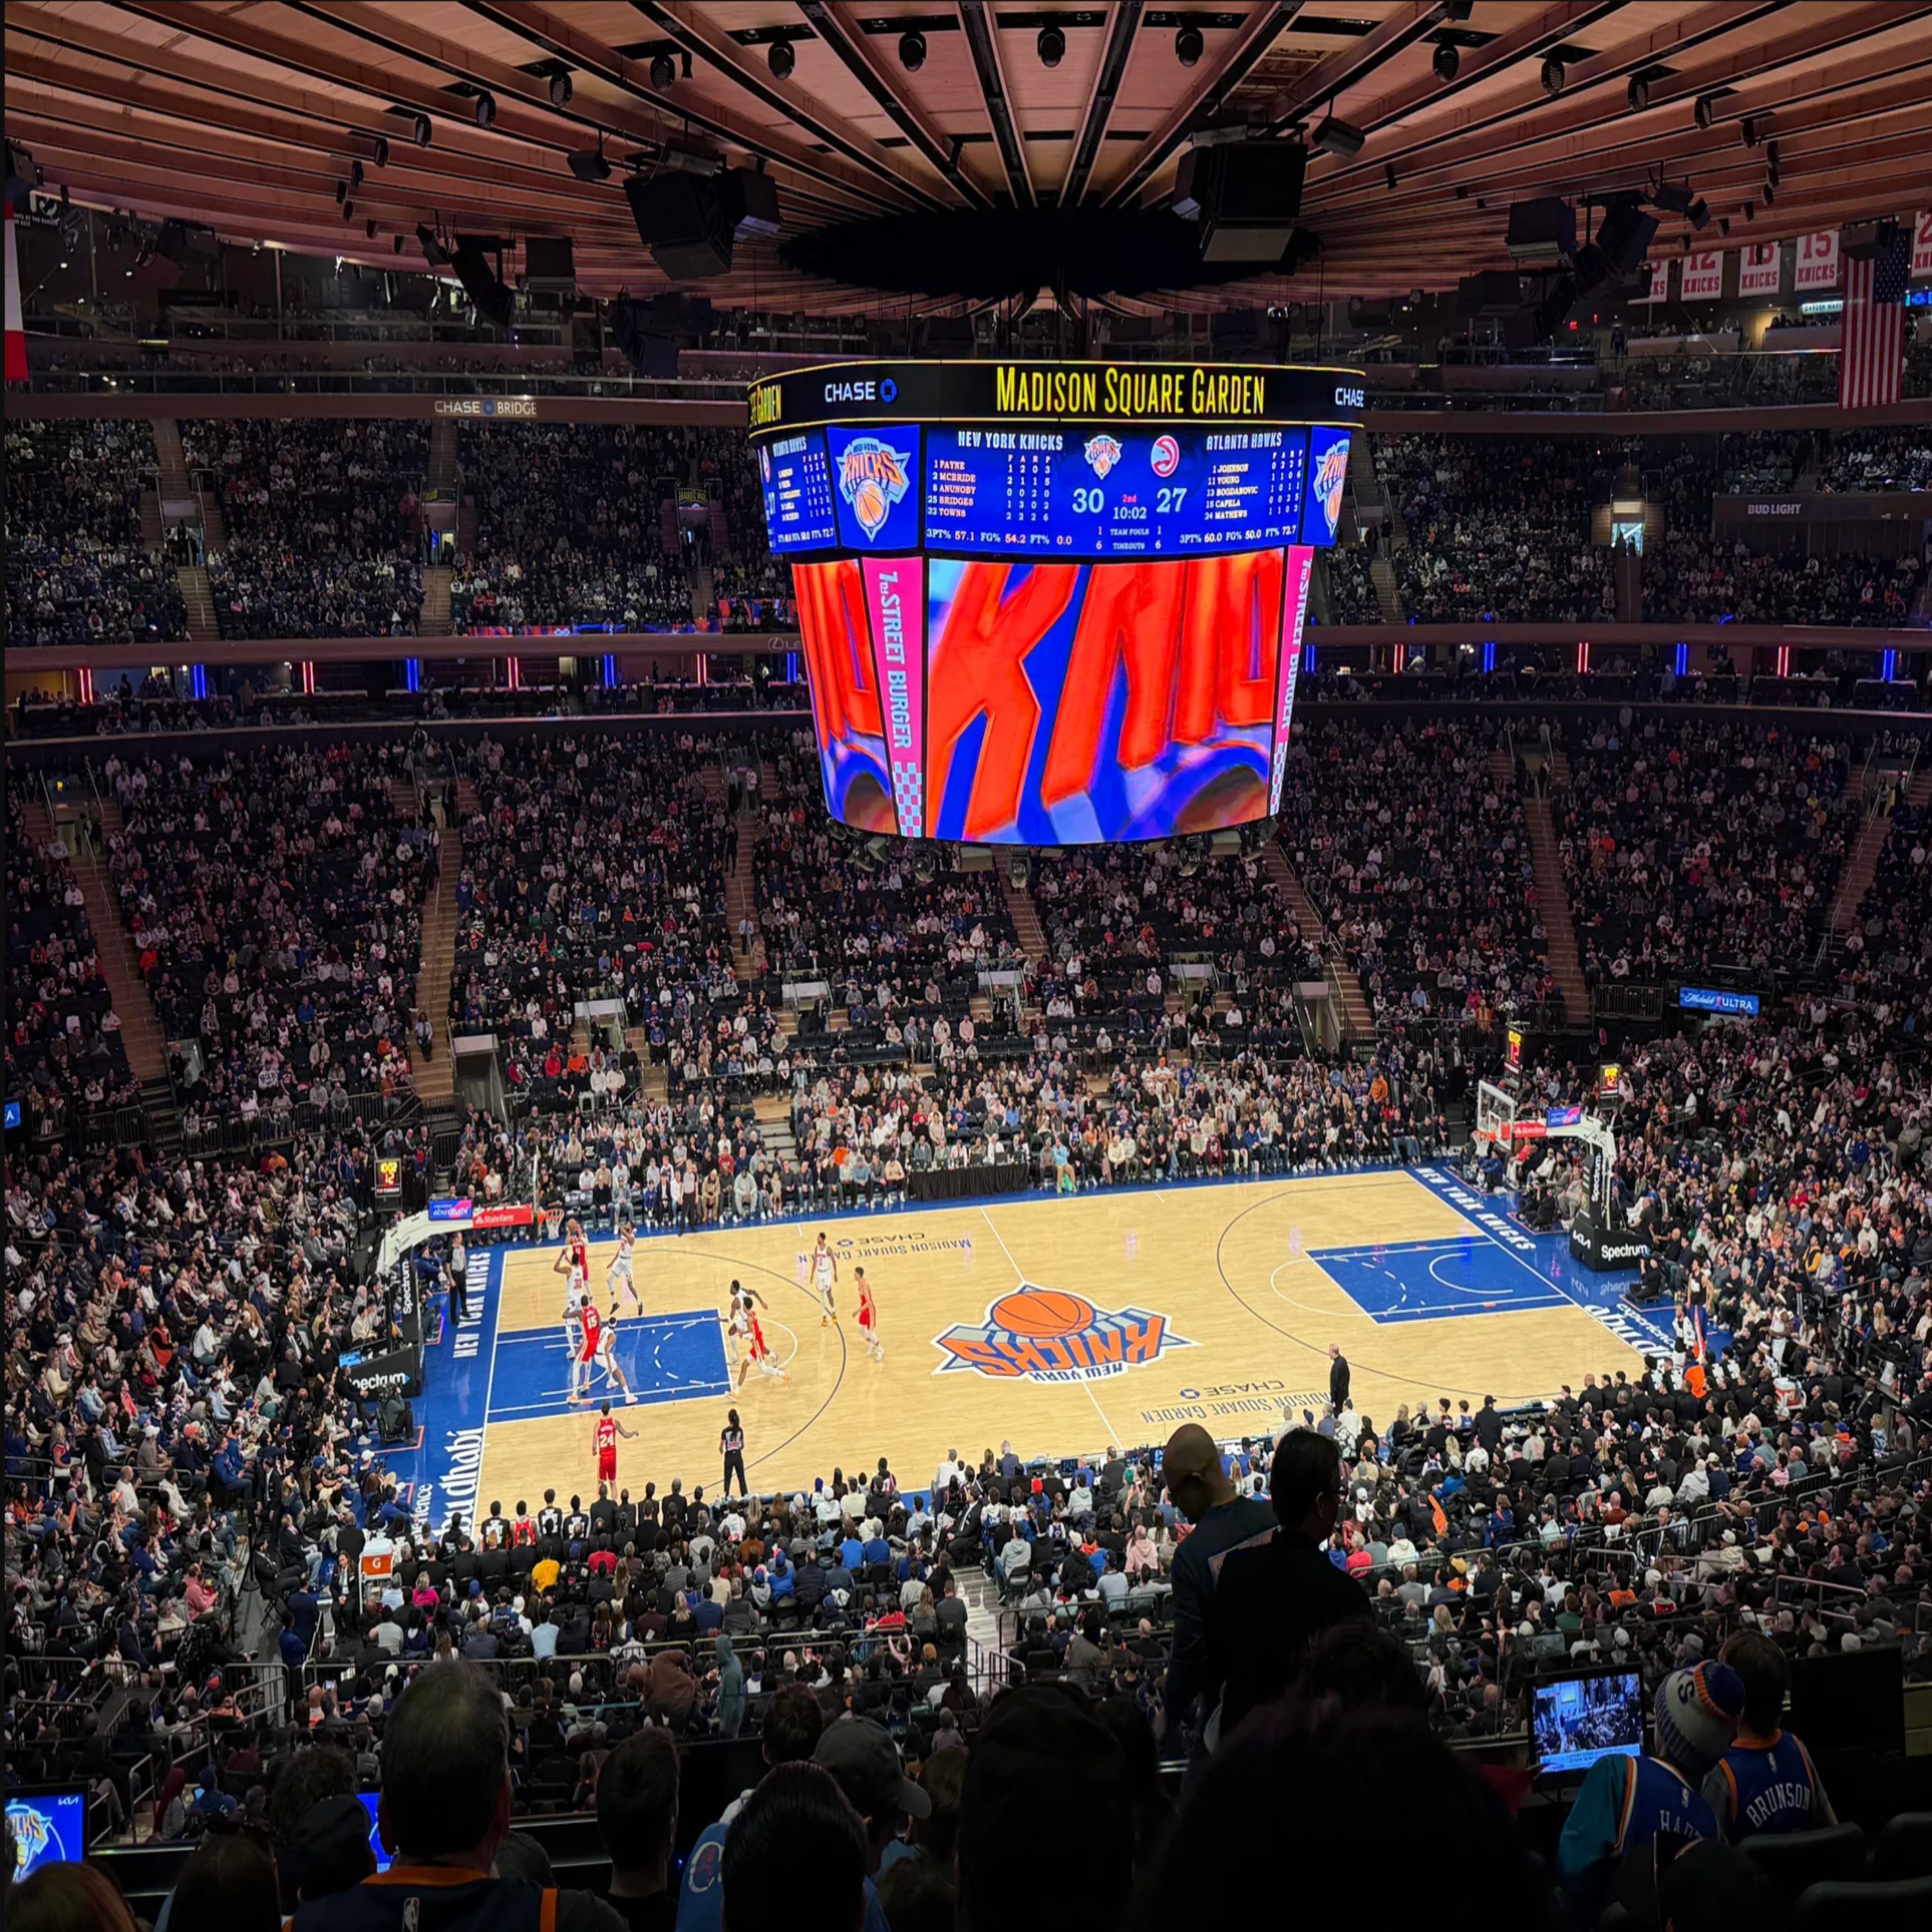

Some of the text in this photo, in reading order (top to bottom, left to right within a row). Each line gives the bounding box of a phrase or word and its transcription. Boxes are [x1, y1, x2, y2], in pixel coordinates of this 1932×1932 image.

[1741, 271, 1777, 290] KNICKS
[1797, 264, 1835, 283] KNICKS
[1683, 276, 1720, 293] KNICKS
[825, 381, 876, 402] CHASE
[997, 367, 1264, 416] MADISON SQUARE GARDEN
[1335, 387, 1364, 408] CHASE
[435, 401, 537, 415] CHASE BRIDGE
[958, 431, 1063, 451] NEW YORK KNICKS
[1206, 431, 1282, 451] ATLANTA HAWKS
[844, 451, 905, 487] KNICKS
[934, 460, 938, 468] 1
[940, 460, 965, 470] PAYNE
[940, 473, 976, 482] MCBRIDE
[1217, 476, 1240, 485] YOUNG
[939, 485, 976, 495] ANUNOBY
[1122, 494, 1137, 503] 2nd
[939, 497, 974, 506] BRIDGES
[1072, 488, 1104, 513] 30
[1156, 487, 1188, 513] 27
[1215, 499, 1240, 508] CAPELA
[939, 508, 966, 517] TOWNS
[1113, 507, 1147, 520] 10:02
[1215, 510, 1247, 520] MATHEWS
[1748, 504, 1801, 515] BUD LIGHT
[926, 528, 1072, 545] 3PT% 57.1 FG% 54.2 FT% 0.0
[1098, 526, 1102, 535] 1
[1157, 526, 1161, 535] 1
[1179, 525, 1296, 544] 3PT% 60.0 FG% 50.0 FT% 72.7
[1096, 540, 1102, 549] 6
[1155, 540, 1161, 549] 6
[881, 594, 905, 665] STREET
[887, 670, 912, 749] BURGER
[1722, 998, 1754, 1010] ULTRA
[1591, 1153, 1602, 1202] Spectrum
[1416, 1168, 1537, 1249] NEW YORK KNICKS
[857, 1233, 925, 1245] CHASE
[911, 1238, 972, 1252] MADISON
[1572, 1229, 1591, 1250] KIA
[857, 1244, 907, 1258] SQUARE
[1601, 1244, 1649, 1261] Spectrum
[401, 1260, 412, 1315] Spectrum
[452, 1332, 480, 1359] NEW
[466, 1252, 491, 1293] KNICKS
[587, 1316, 597, 1330] 15
[939, 1314, 1164, 1376] KNICKS
[1031, 1361, 1123, 1382] NEW YORK
[350, 1372, 406, 1390] pectrum
[1203, 1380, 1285, 1397] CHASE
[1141, 1392, 1331, 1423] ADISON SQUARE GARDEN
[600, 1433, 614, 1447] 24
[372, 1557, 381, 1569] G
[58, 1797, 79, 1806] KIA
[1746, 1781, 1812, 1829] BRUNSON
